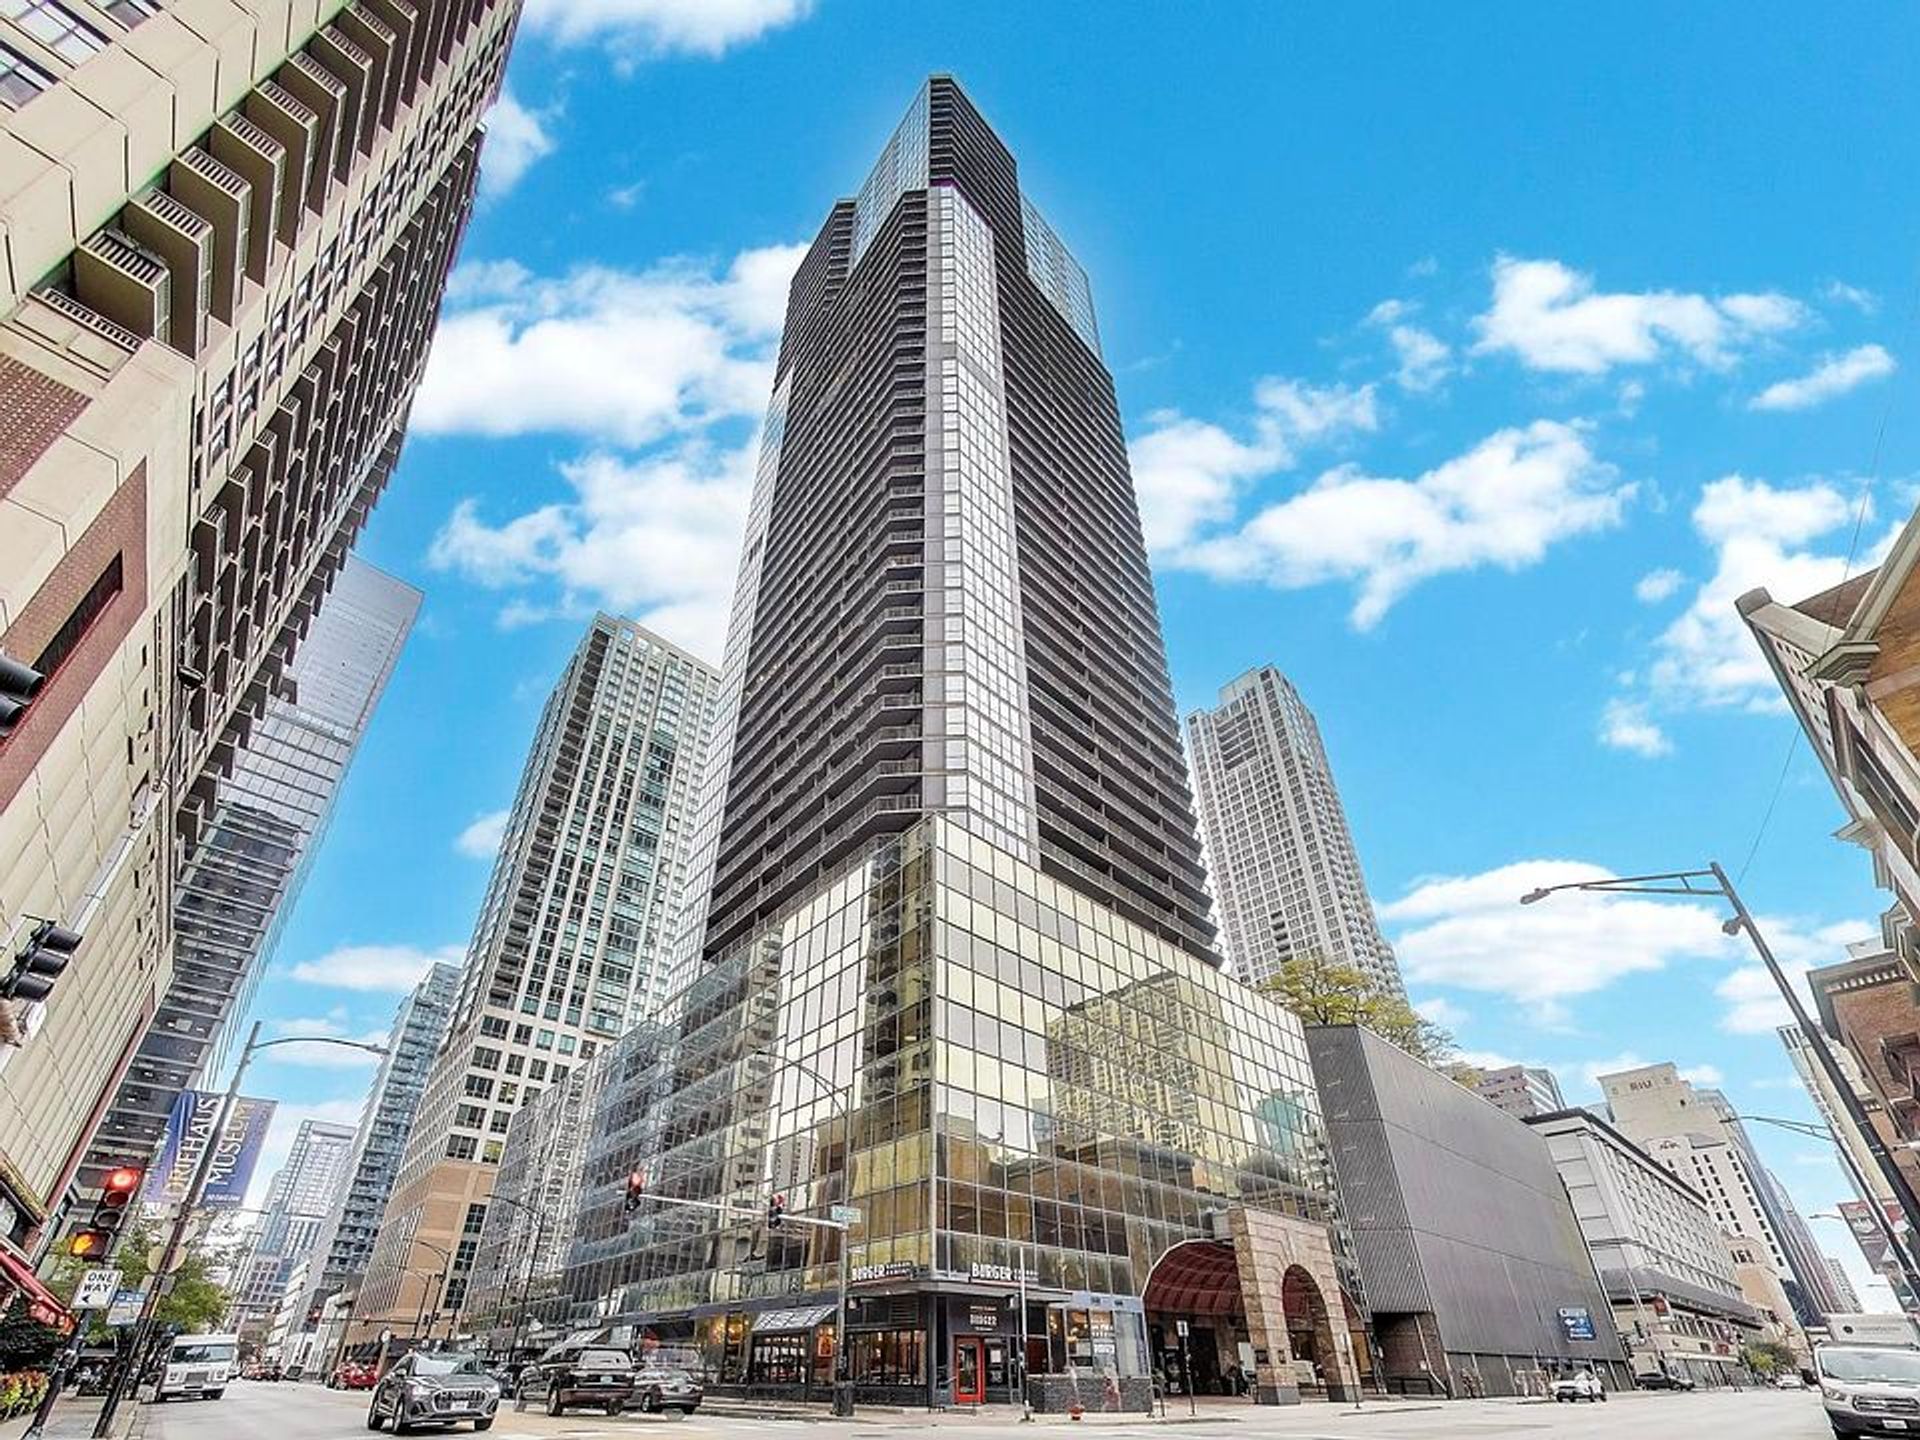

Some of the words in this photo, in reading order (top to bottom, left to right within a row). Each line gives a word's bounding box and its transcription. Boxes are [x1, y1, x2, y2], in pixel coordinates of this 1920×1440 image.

[161, 1098, 219, 1198] DRIEHAUS
[206, 1103, 255, 1185] MUSEUM
[88, 1272, 114, 1281] ONE
[971, 1262, 1012, 1281] BURGER
[84, 1283, 111, 1292] WAY
